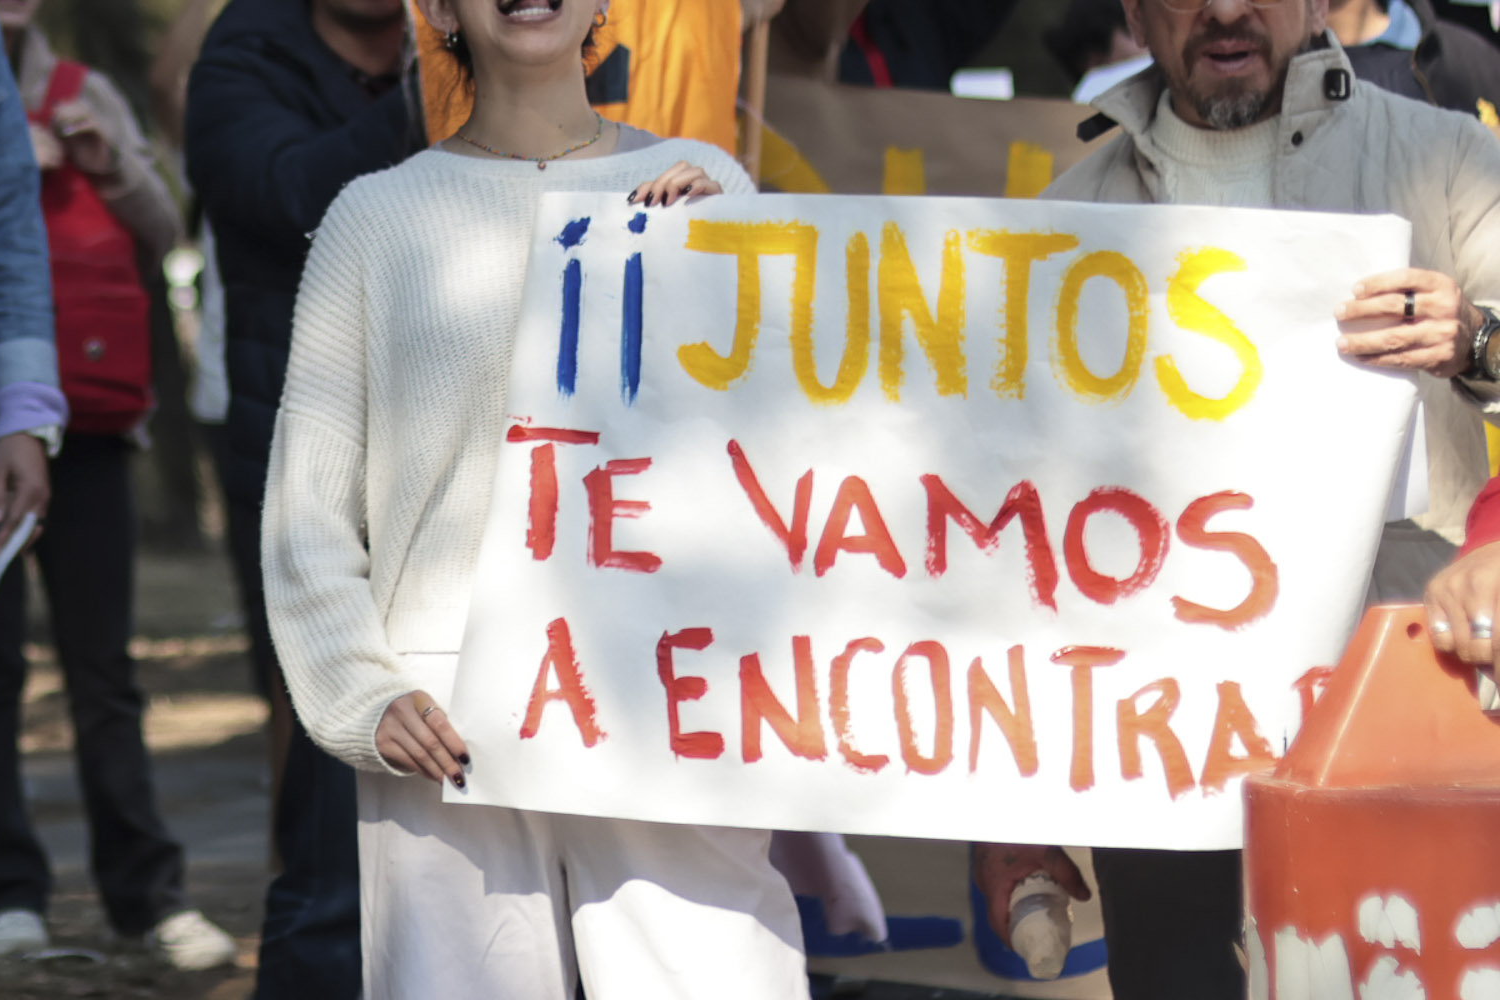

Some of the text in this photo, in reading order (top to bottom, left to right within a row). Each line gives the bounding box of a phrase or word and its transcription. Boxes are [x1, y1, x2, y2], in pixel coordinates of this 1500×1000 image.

[506, 415, 1279, 631] TE VAMOS
[518, 615, 609, 748] A
